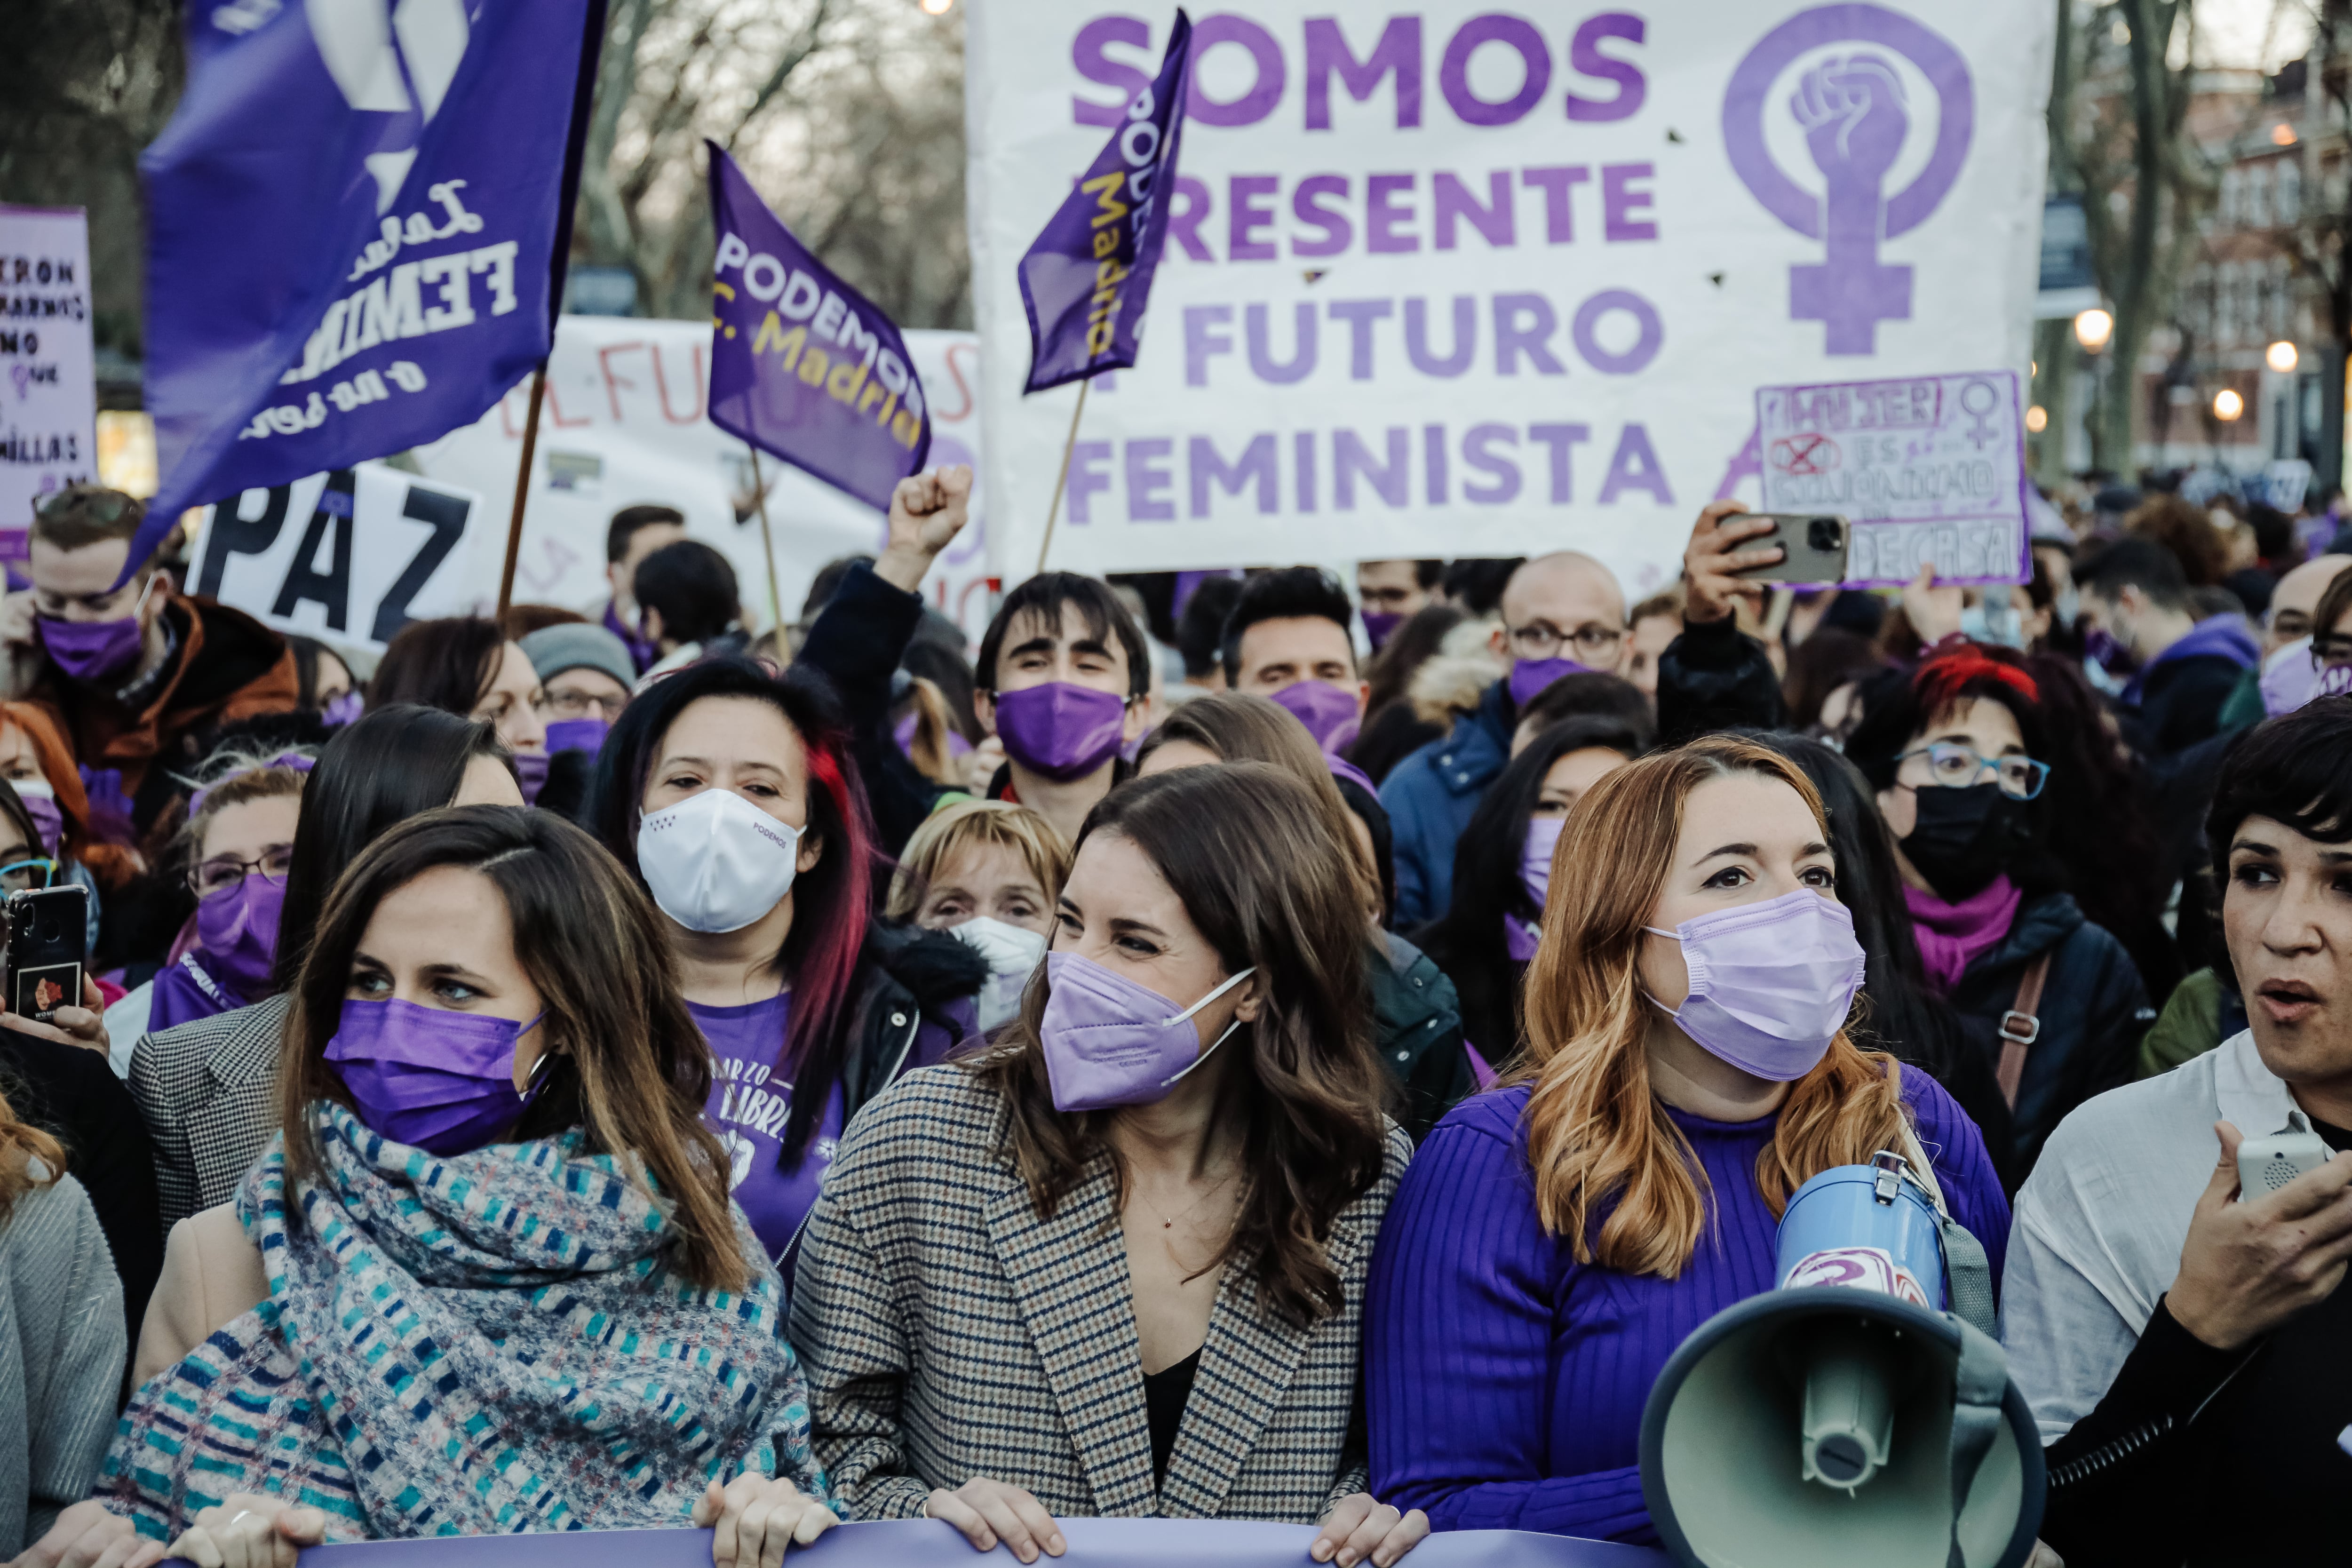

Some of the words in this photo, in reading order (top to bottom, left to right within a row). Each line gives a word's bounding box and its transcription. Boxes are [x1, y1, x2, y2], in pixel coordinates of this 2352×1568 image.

[1071, 11, 1649, 131] SOMOS
[1073, 161, 1660, 263] RESENTE
[0, 258, 73, 284] RON
[1182, 288, 1664, 388] FUTURO
[1063, 422, 1677, 525] FEMINISTA
[198, 470, 471, 642] PAZ
[753, 822, 787, 849] PODEMOS
